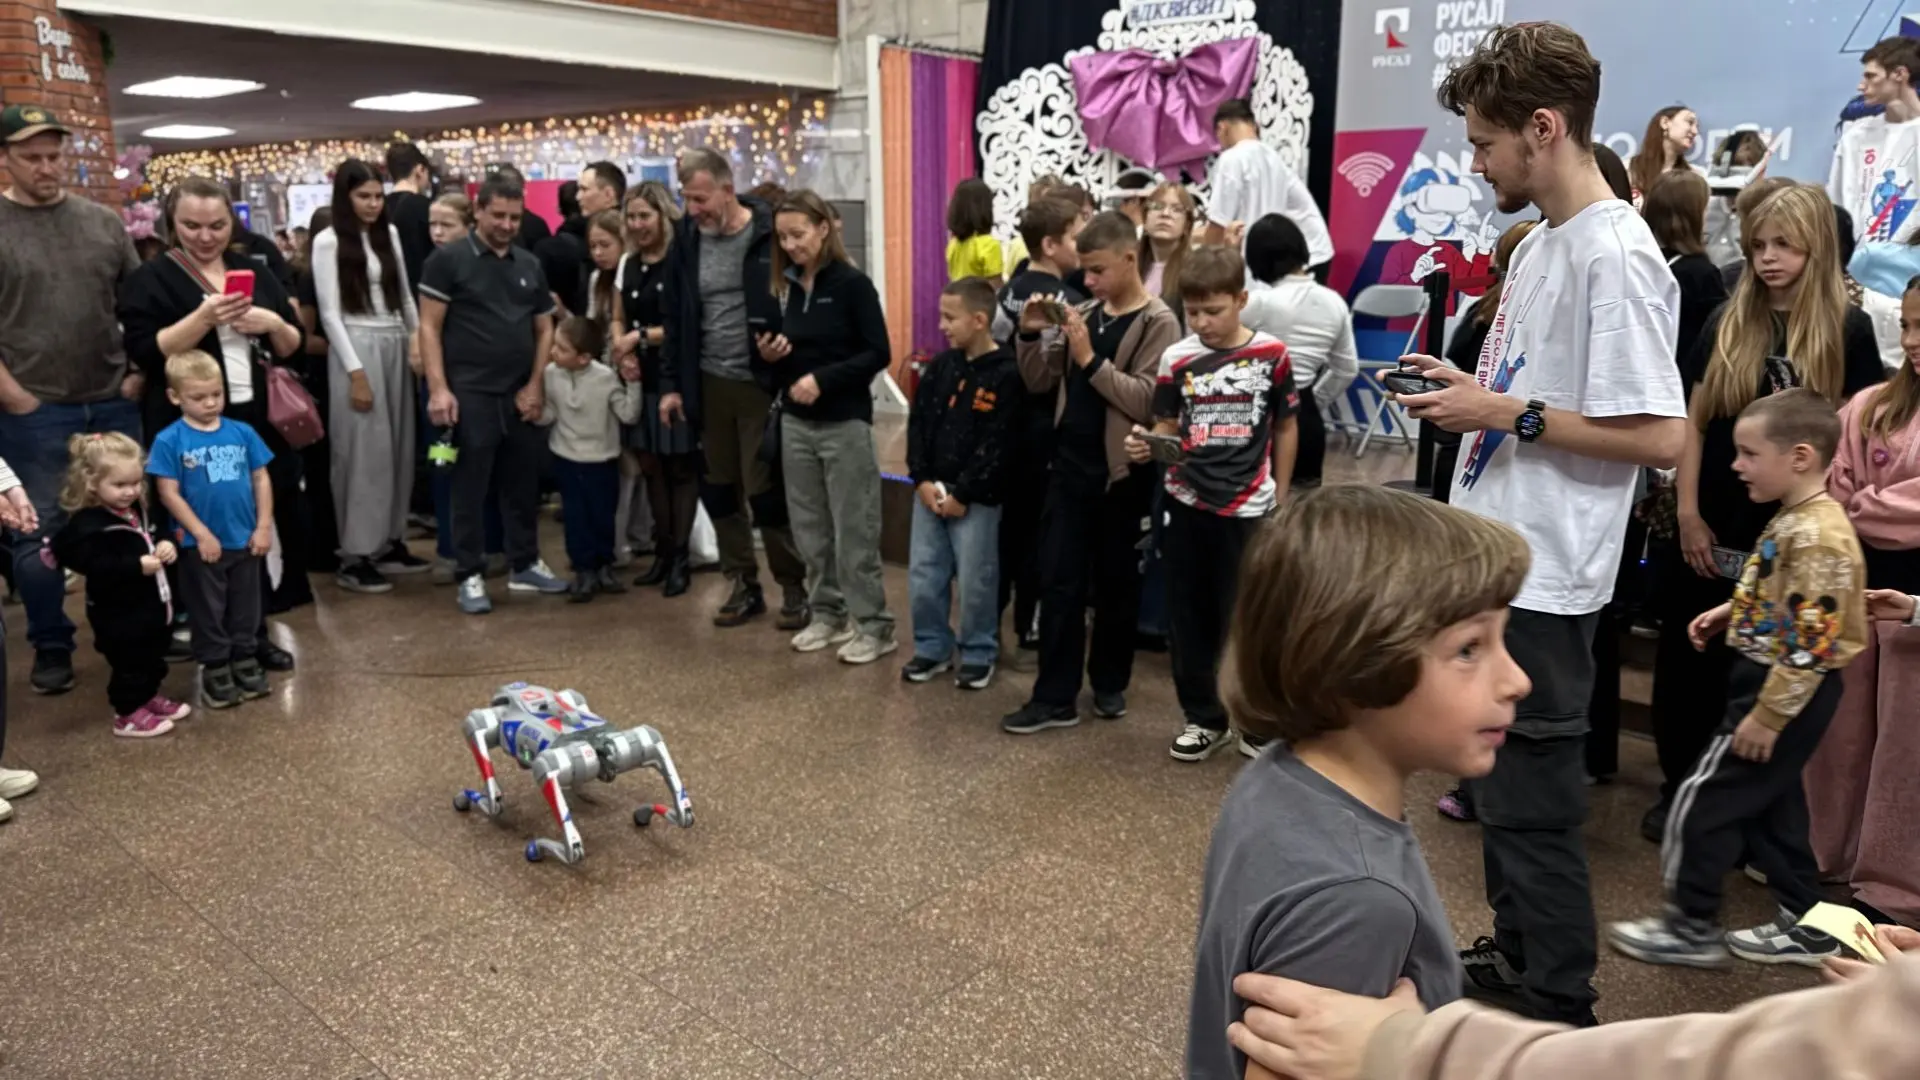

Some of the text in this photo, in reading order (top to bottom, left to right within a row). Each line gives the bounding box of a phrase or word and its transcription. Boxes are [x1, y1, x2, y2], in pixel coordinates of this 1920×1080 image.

[1435, 0, 1505, 30] РУСАЛ
[1433, 29, 1506, 58] ФЕСТ
[1494, 313, 1506, 335] ЛЕТ
[1191, 411, 1254, 424] CHAMPIONSHIP
